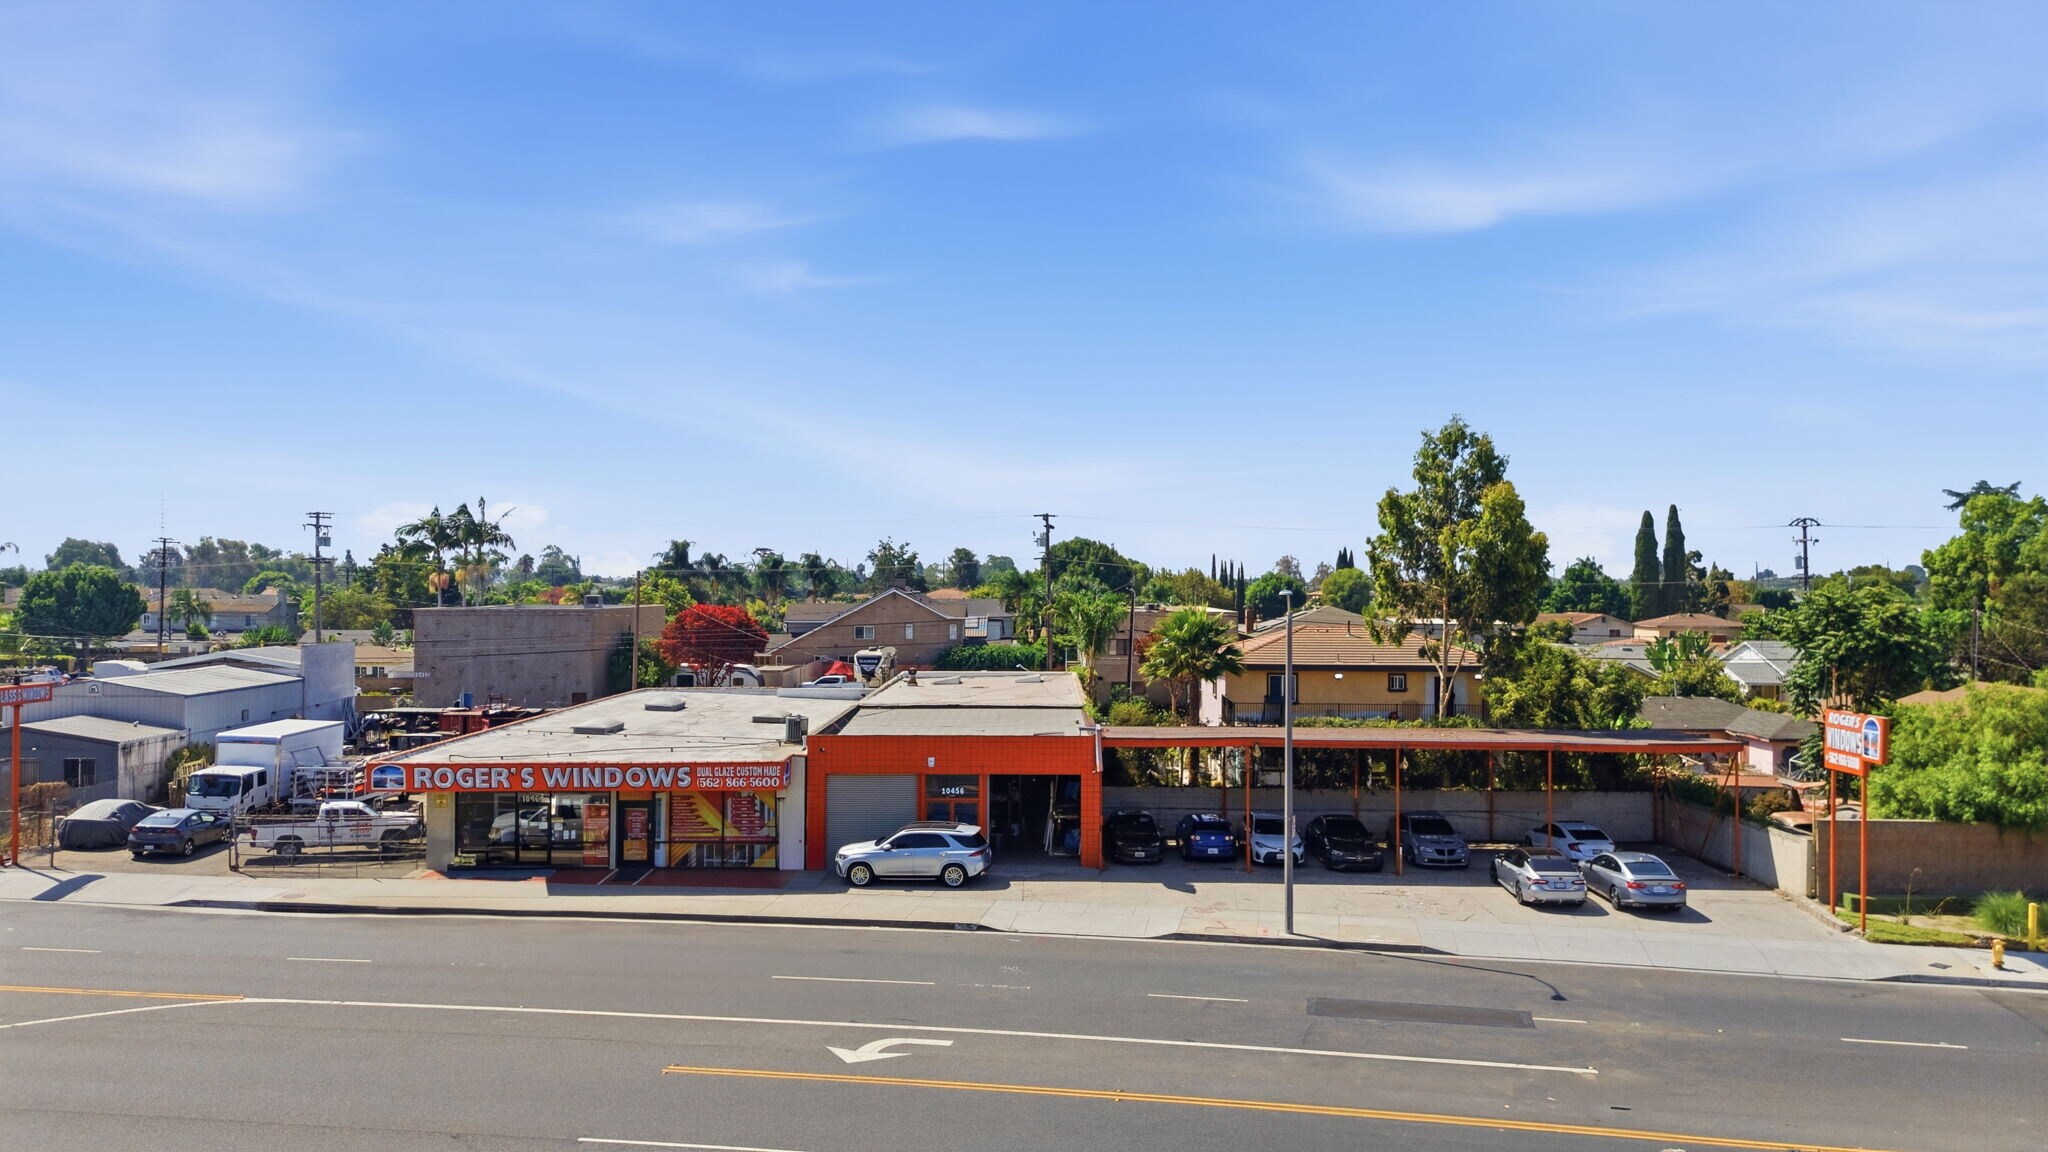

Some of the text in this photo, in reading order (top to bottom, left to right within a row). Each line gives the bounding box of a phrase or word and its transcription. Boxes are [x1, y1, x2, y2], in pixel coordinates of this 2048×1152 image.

[1829, 712, 1860, 728] ROGER'S
[1826, 727, 1862, 755] WINDOWS
[413, 767, 692, 789] ROGER'S WINDOWS
[696, 766, 781, 777] DUAL GLAZE CUSTOM MADE
[696, 777, 780, 788] (562) 866-5600
